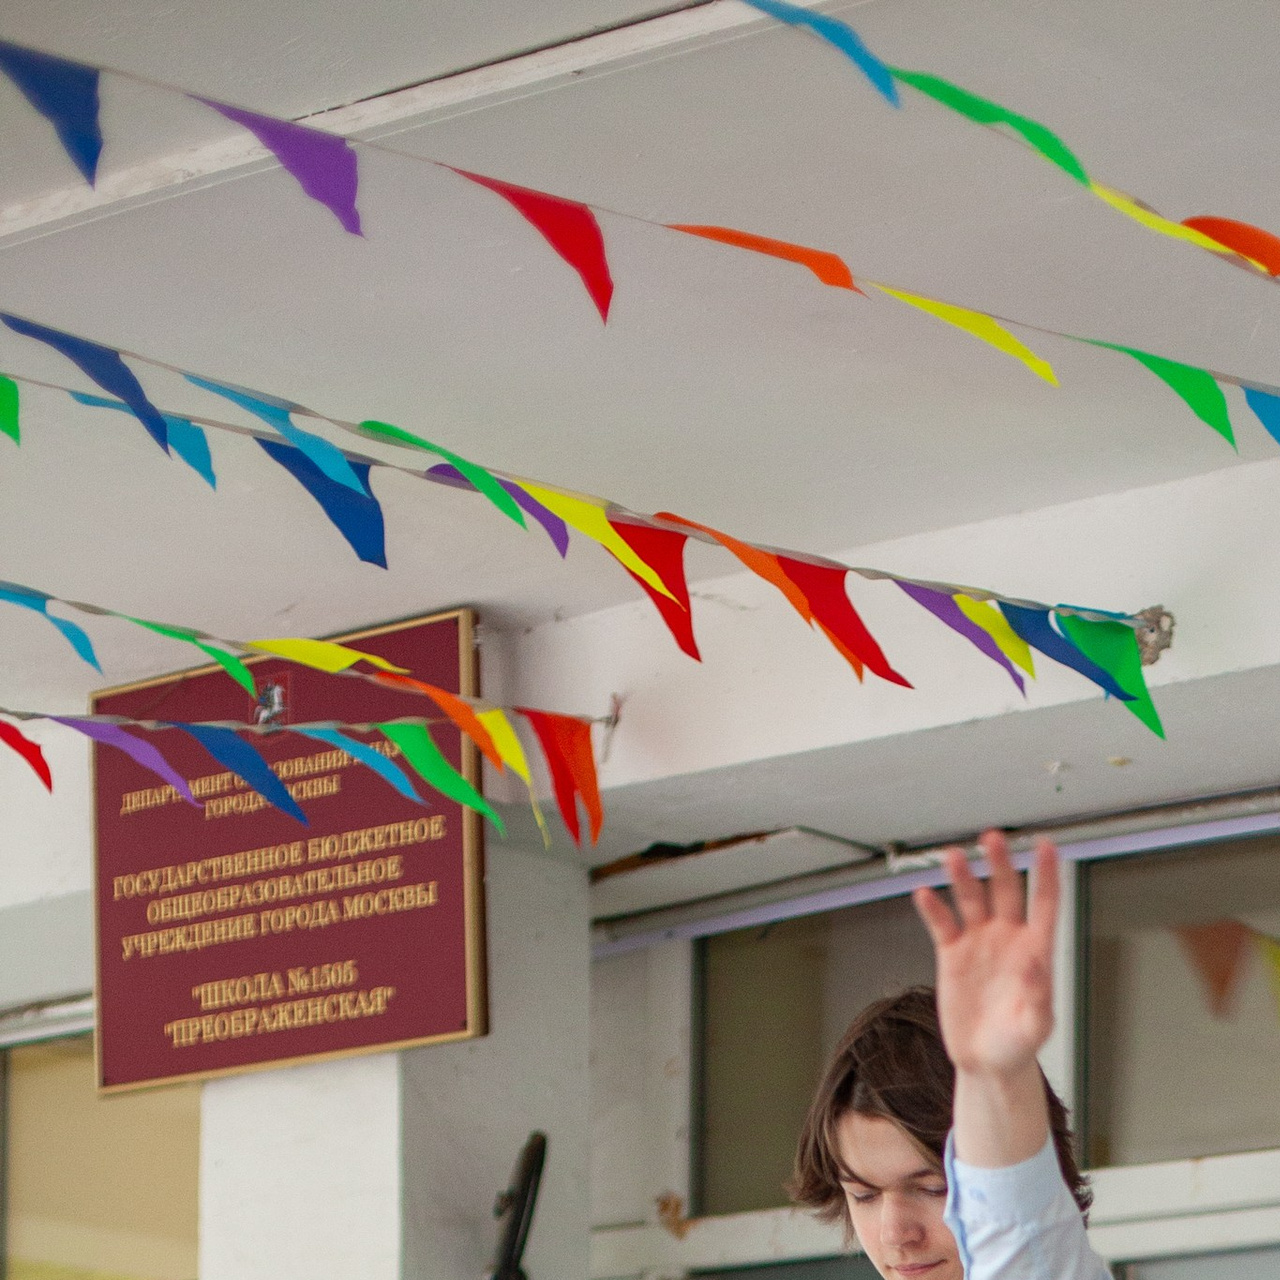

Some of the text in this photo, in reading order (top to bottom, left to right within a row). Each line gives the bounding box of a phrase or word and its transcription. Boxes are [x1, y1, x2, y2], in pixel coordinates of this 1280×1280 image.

[120, 771, 234, 816] ДЕПАРТМЕНТ
[113, 815, 446, 900] ГОСУДАРСТВЕННОЕ БЮДЖЕТНОЕ
[147, 855, 403, 925] ОБЩЕОБРАЗОВАТЕЛЬНОЕ
[122, 881, 438, 960] УЧРЕЖДЕНИЕ ГОРОДА МОСКВЫ
[164, 986, 397, 1049] "ПРЕОБРАЖЕНСКАЯ"
